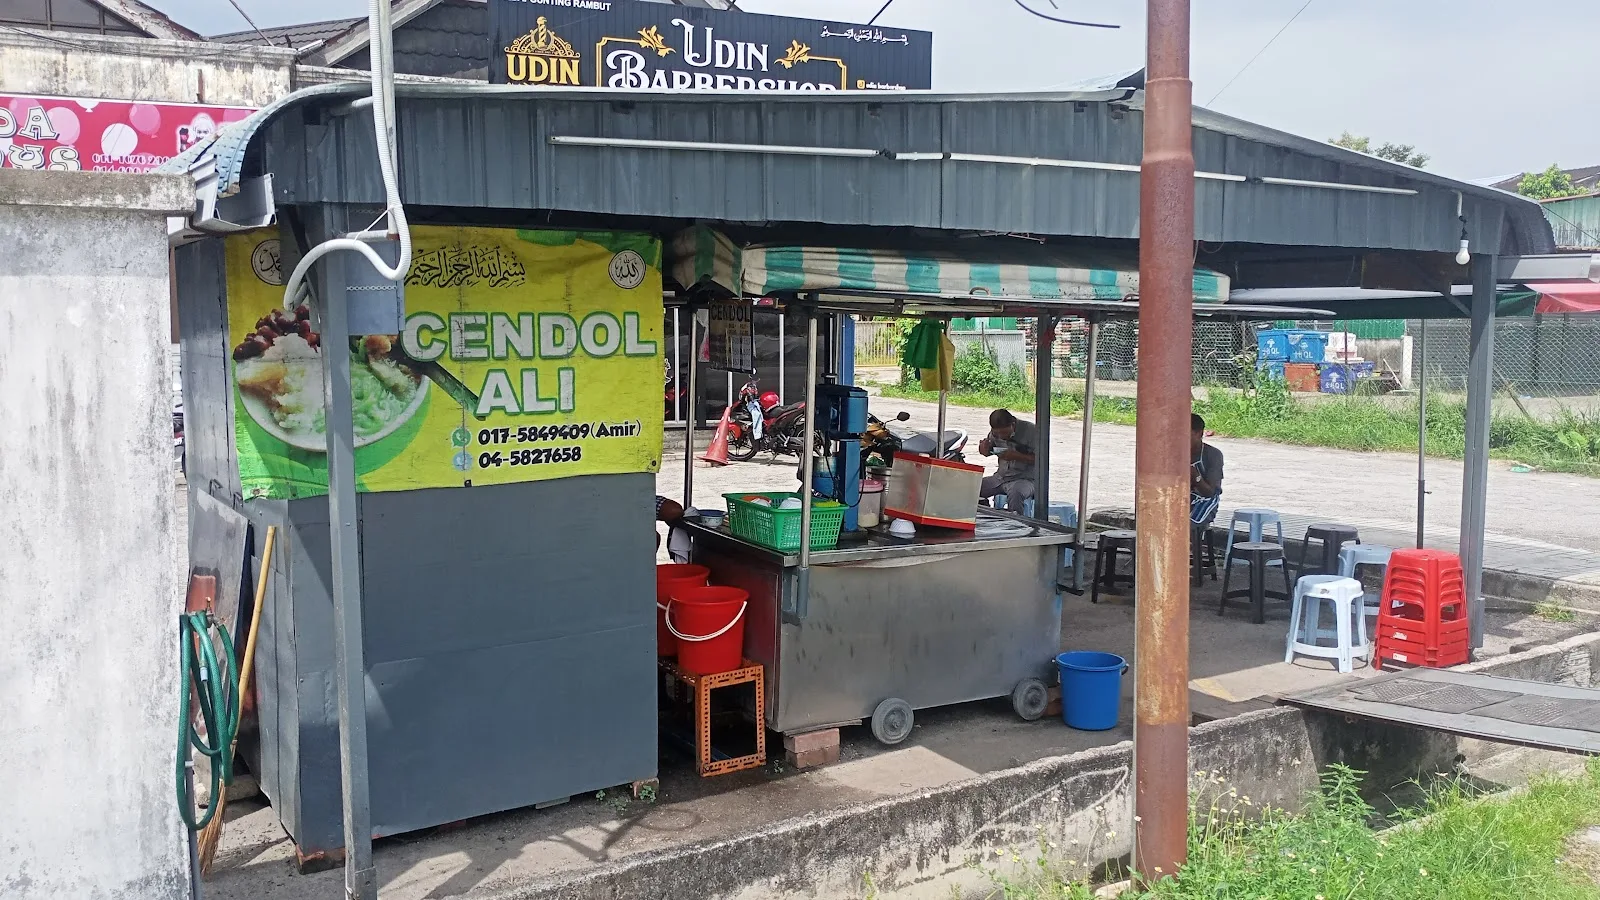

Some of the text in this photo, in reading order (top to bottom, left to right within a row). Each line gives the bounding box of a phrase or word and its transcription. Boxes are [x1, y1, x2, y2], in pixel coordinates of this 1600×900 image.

[573, 0, 612, 10] RAMBUT
[671, 18, 769, 72] UDIN
[506, 54, 580, 85] UDIN
[402, 312, 657, 361] CENDOL
[475, 368, 575, 416] ALI
[478, 447, 581, 469] 04-5827658
